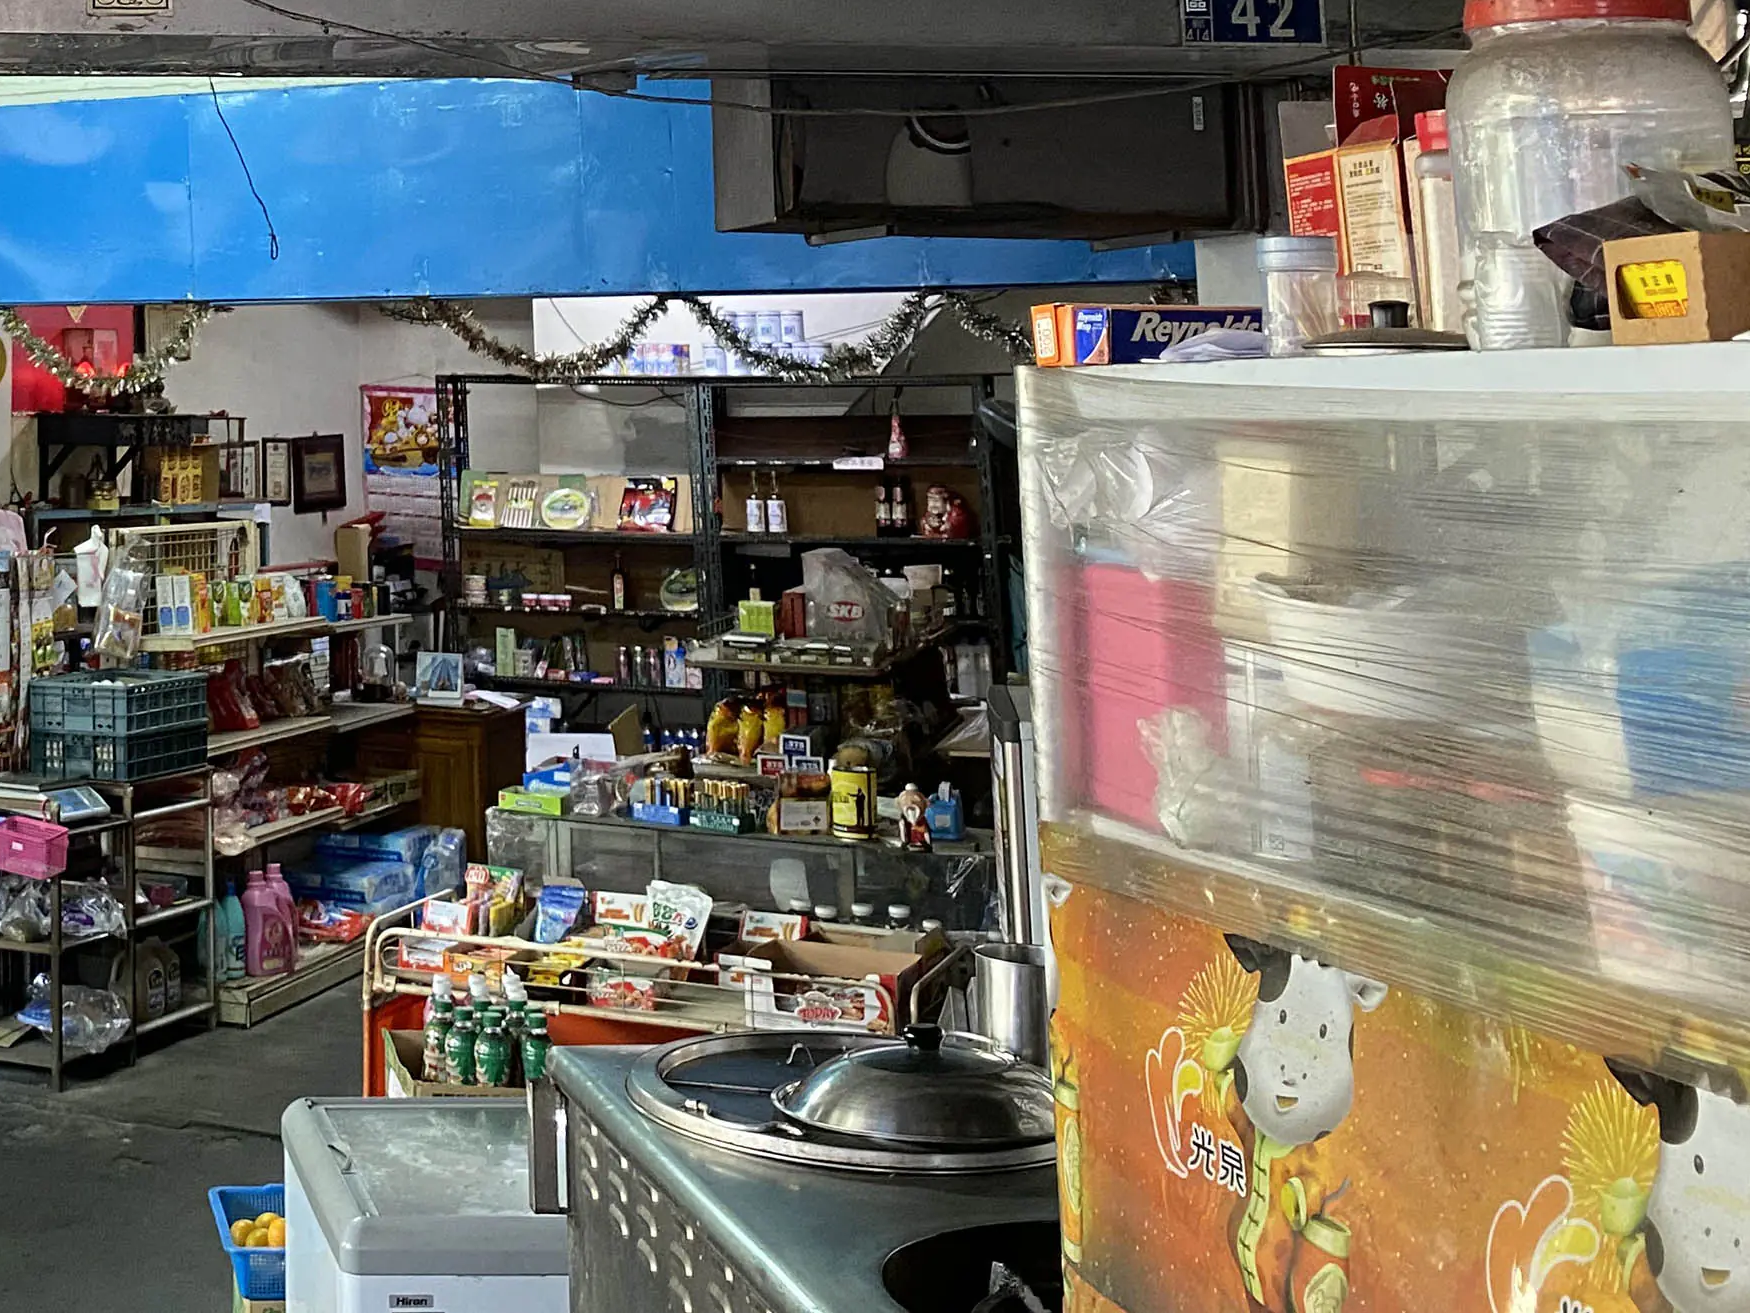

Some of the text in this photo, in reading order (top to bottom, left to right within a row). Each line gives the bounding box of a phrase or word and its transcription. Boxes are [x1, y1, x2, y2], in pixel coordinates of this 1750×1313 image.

[829, 603, 862, 618] SKB
[1188, 1124, 1246, 1196] 光泉
[396, 1296, 428, 1307] Hiron
